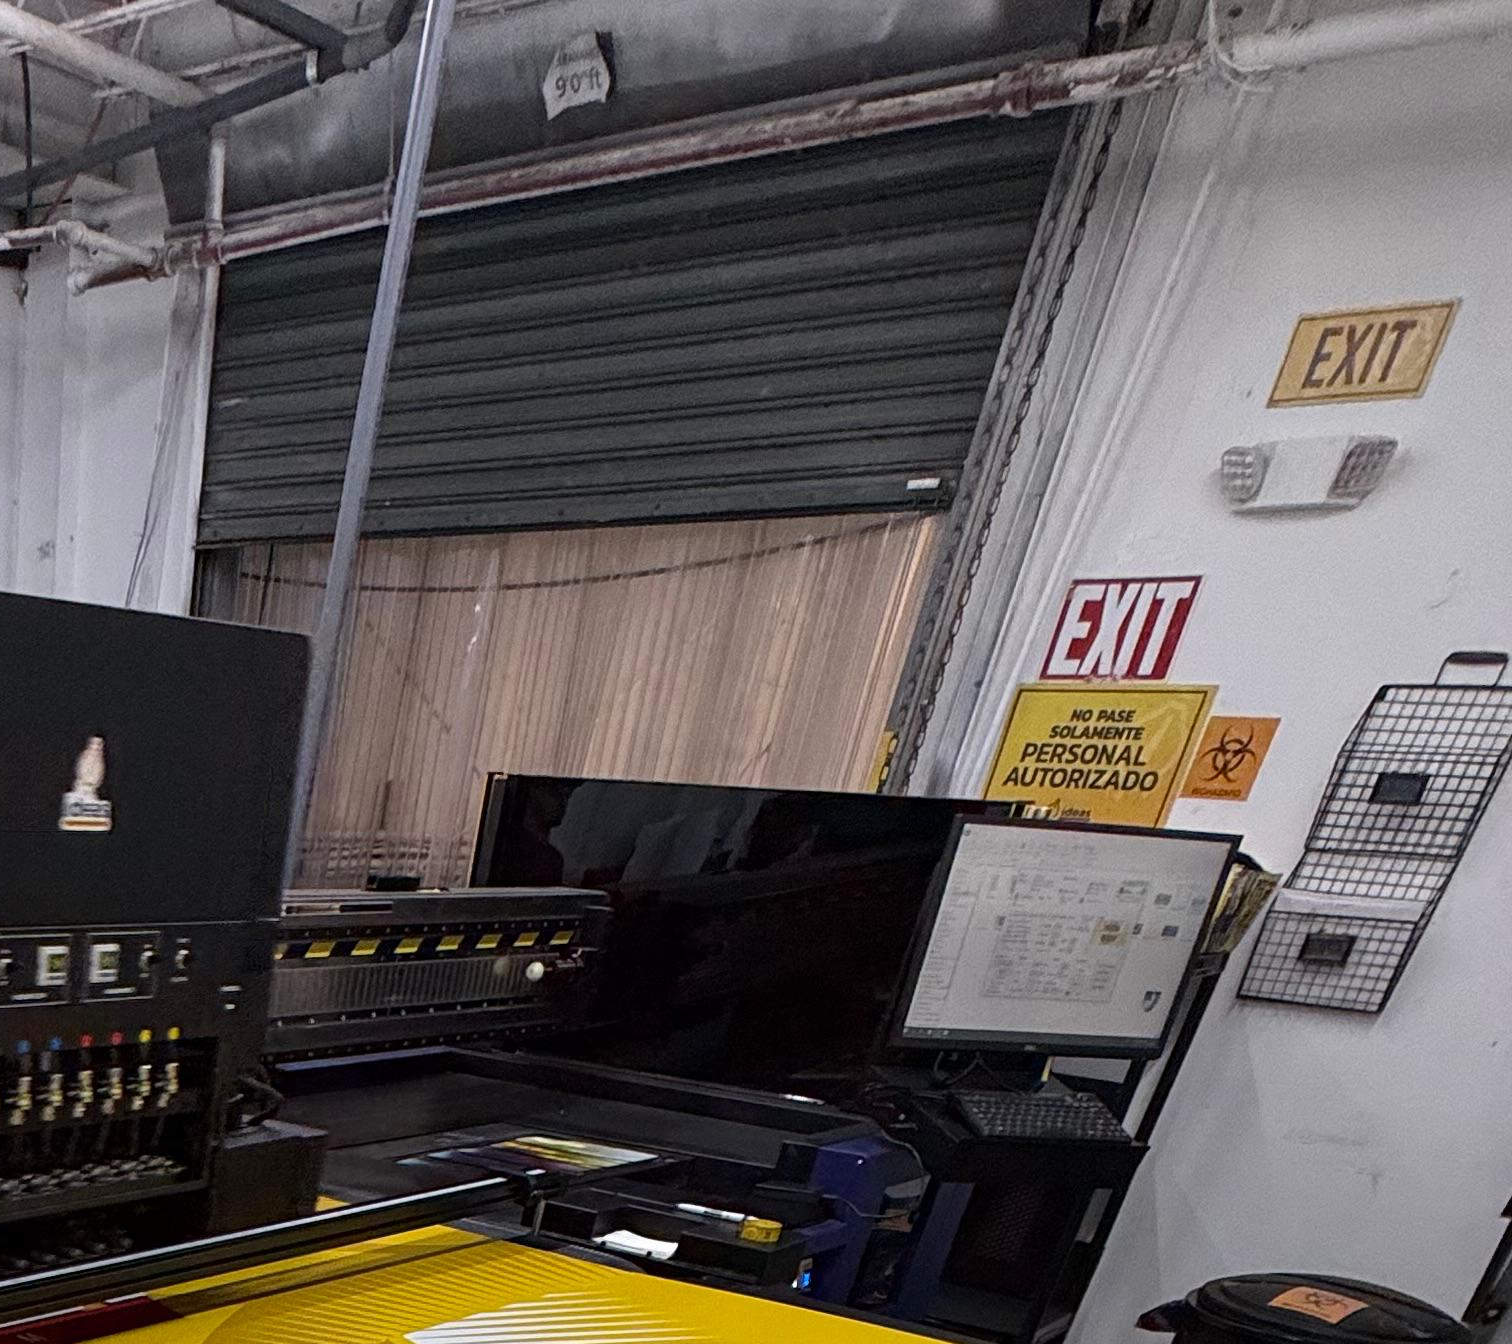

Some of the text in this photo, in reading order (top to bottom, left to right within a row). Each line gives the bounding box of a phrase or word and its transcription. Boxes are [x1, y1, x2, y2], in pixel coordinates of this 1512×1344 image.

[1301, 319, 1419, 390] EXIT
[1045, 580, 1196, 676] EXIT
[1070, 708, 1136, 723] NO PASE
[1049, 725, 1145, 741] SOLAMENTE
[1019, 743, 1147, 766] PERSONAL
[1002, 767, 1159, 792] AUTORIZADO
